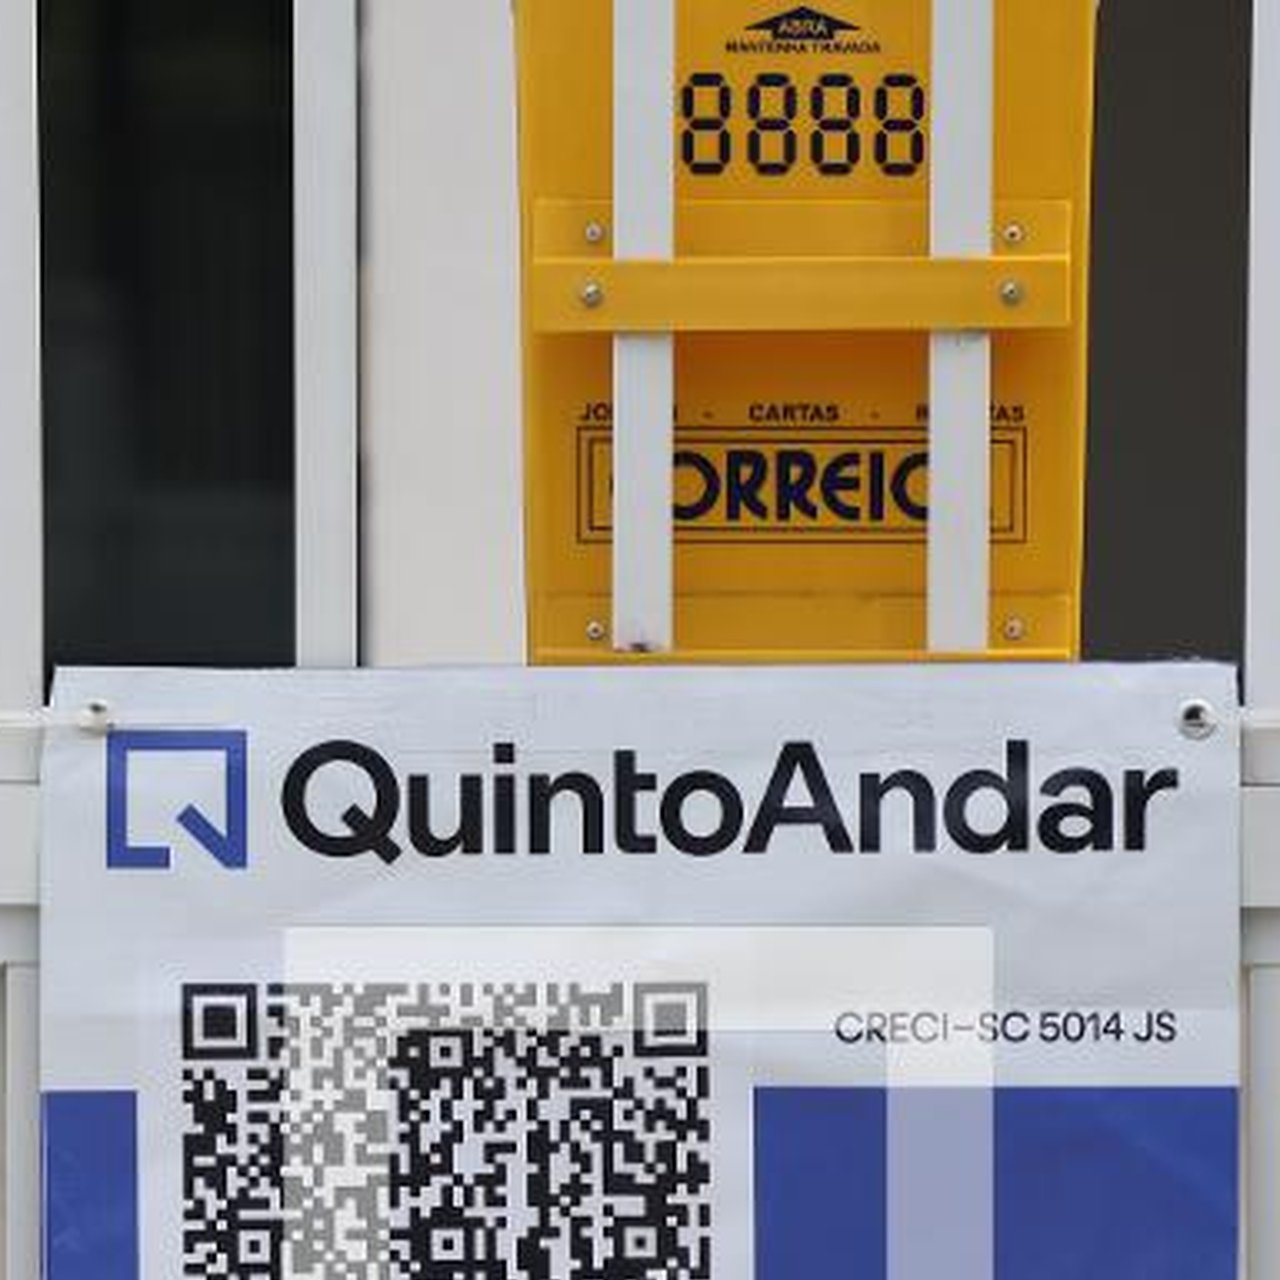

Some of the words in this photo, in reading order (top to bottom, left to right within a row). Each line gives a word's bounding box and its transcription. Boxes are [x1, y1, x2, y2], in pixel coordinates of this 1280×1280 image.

[681, 73, 925, 176] 8888
[748, 403, 840, 422] CARTAS
[610, 451, 992, 520] ORREIO
[280, 739, 1178, 865] QuintoAndar
[1038, 1010, 1125, 1043] 5014
[1132, 1010, 1177, 1043] JS
